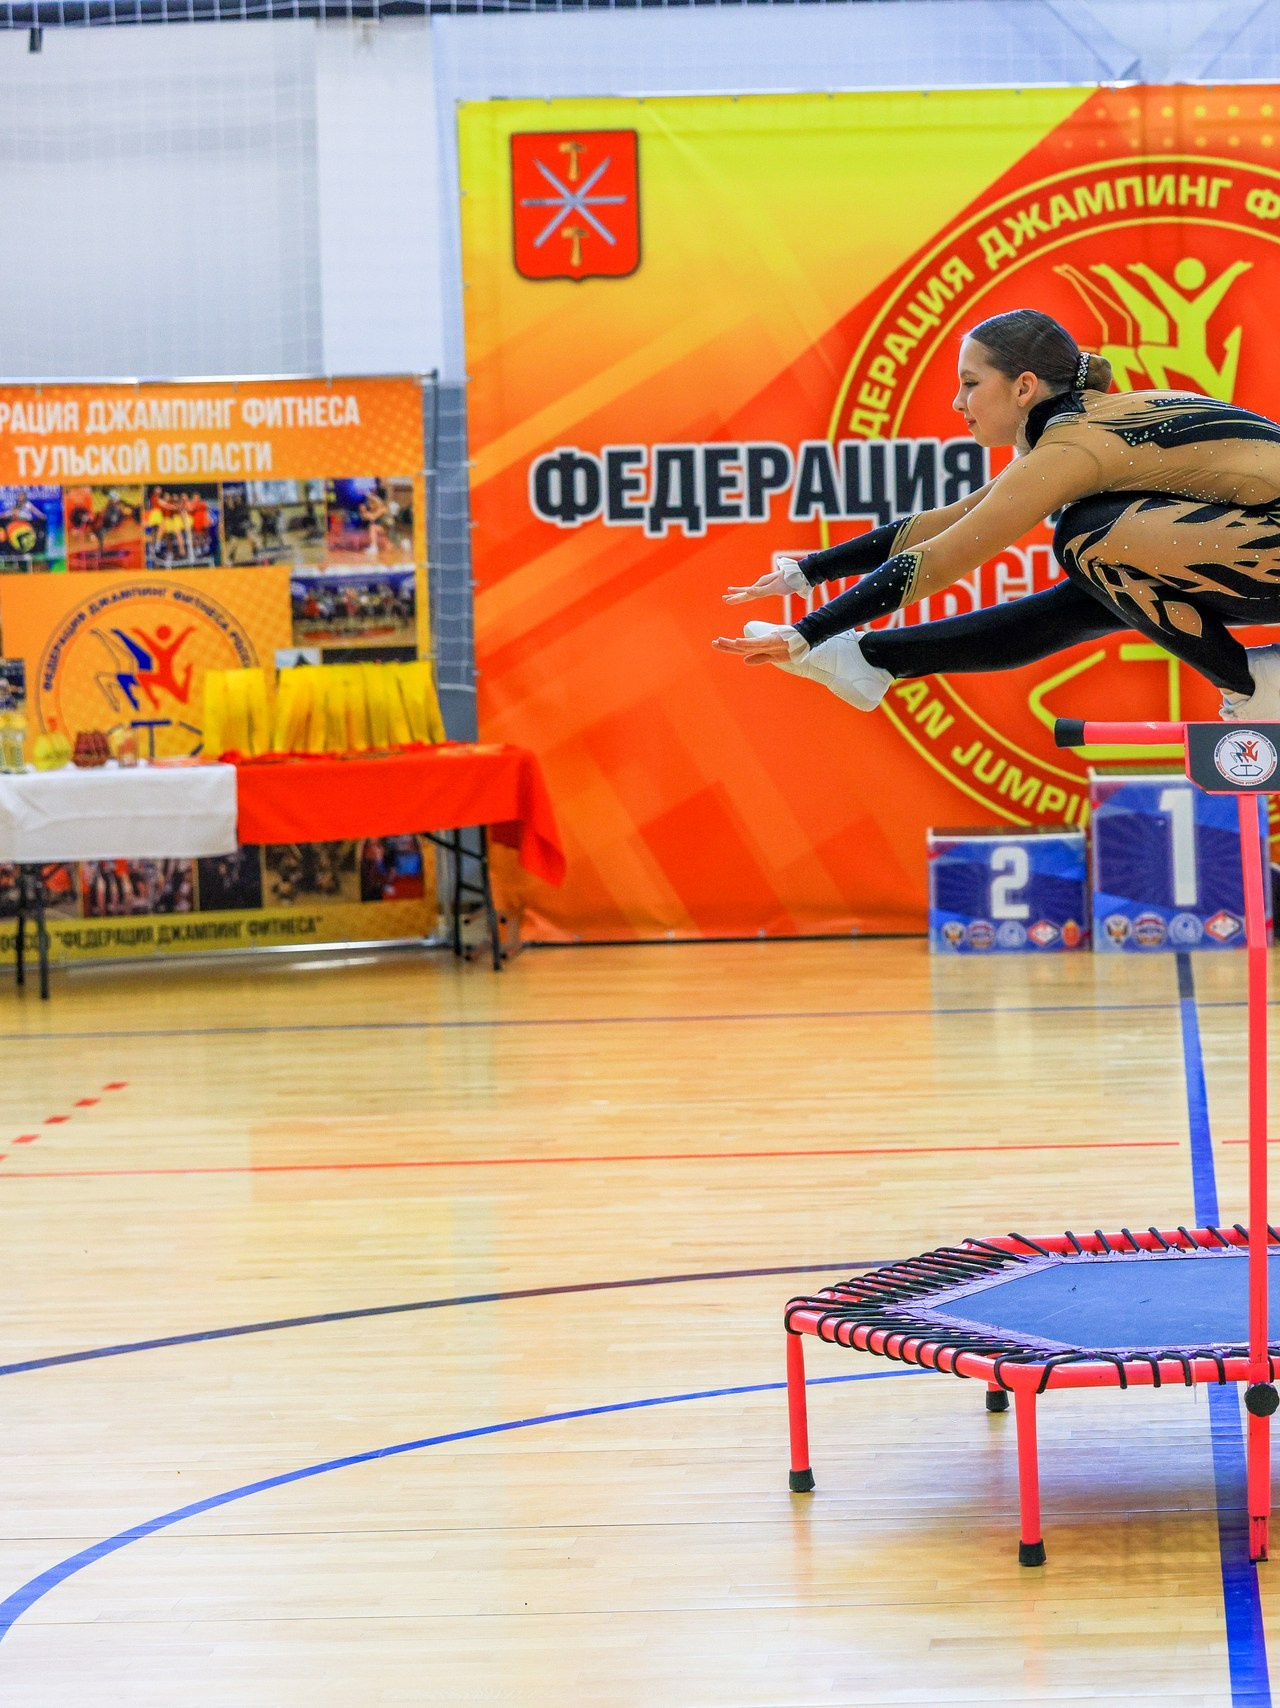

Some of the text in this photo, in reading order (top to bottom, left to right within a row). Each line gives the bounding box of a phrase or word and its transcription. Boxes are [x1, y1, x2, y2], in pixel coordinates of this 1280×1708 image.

[848, 255, 976, 440] ДЕРАЦИЯ
[976, 174, 1233, 271] ДЖАМПИНГ
[85, 398, 236, 434] ДЖАМПИНГ
[242, 395, 361, 428] ФИТНЕСА
[14, 439, 273, 477] ТУЛЬСКОЙ ОБЛАСТИ
[531, 440, 989, 536] ФЕДЕРАЦИЯ
[951, 741, 1090, 827] JUMPI
[989, 846, 1029, 919] 2
[1159, 789, 1197, 905] 1
